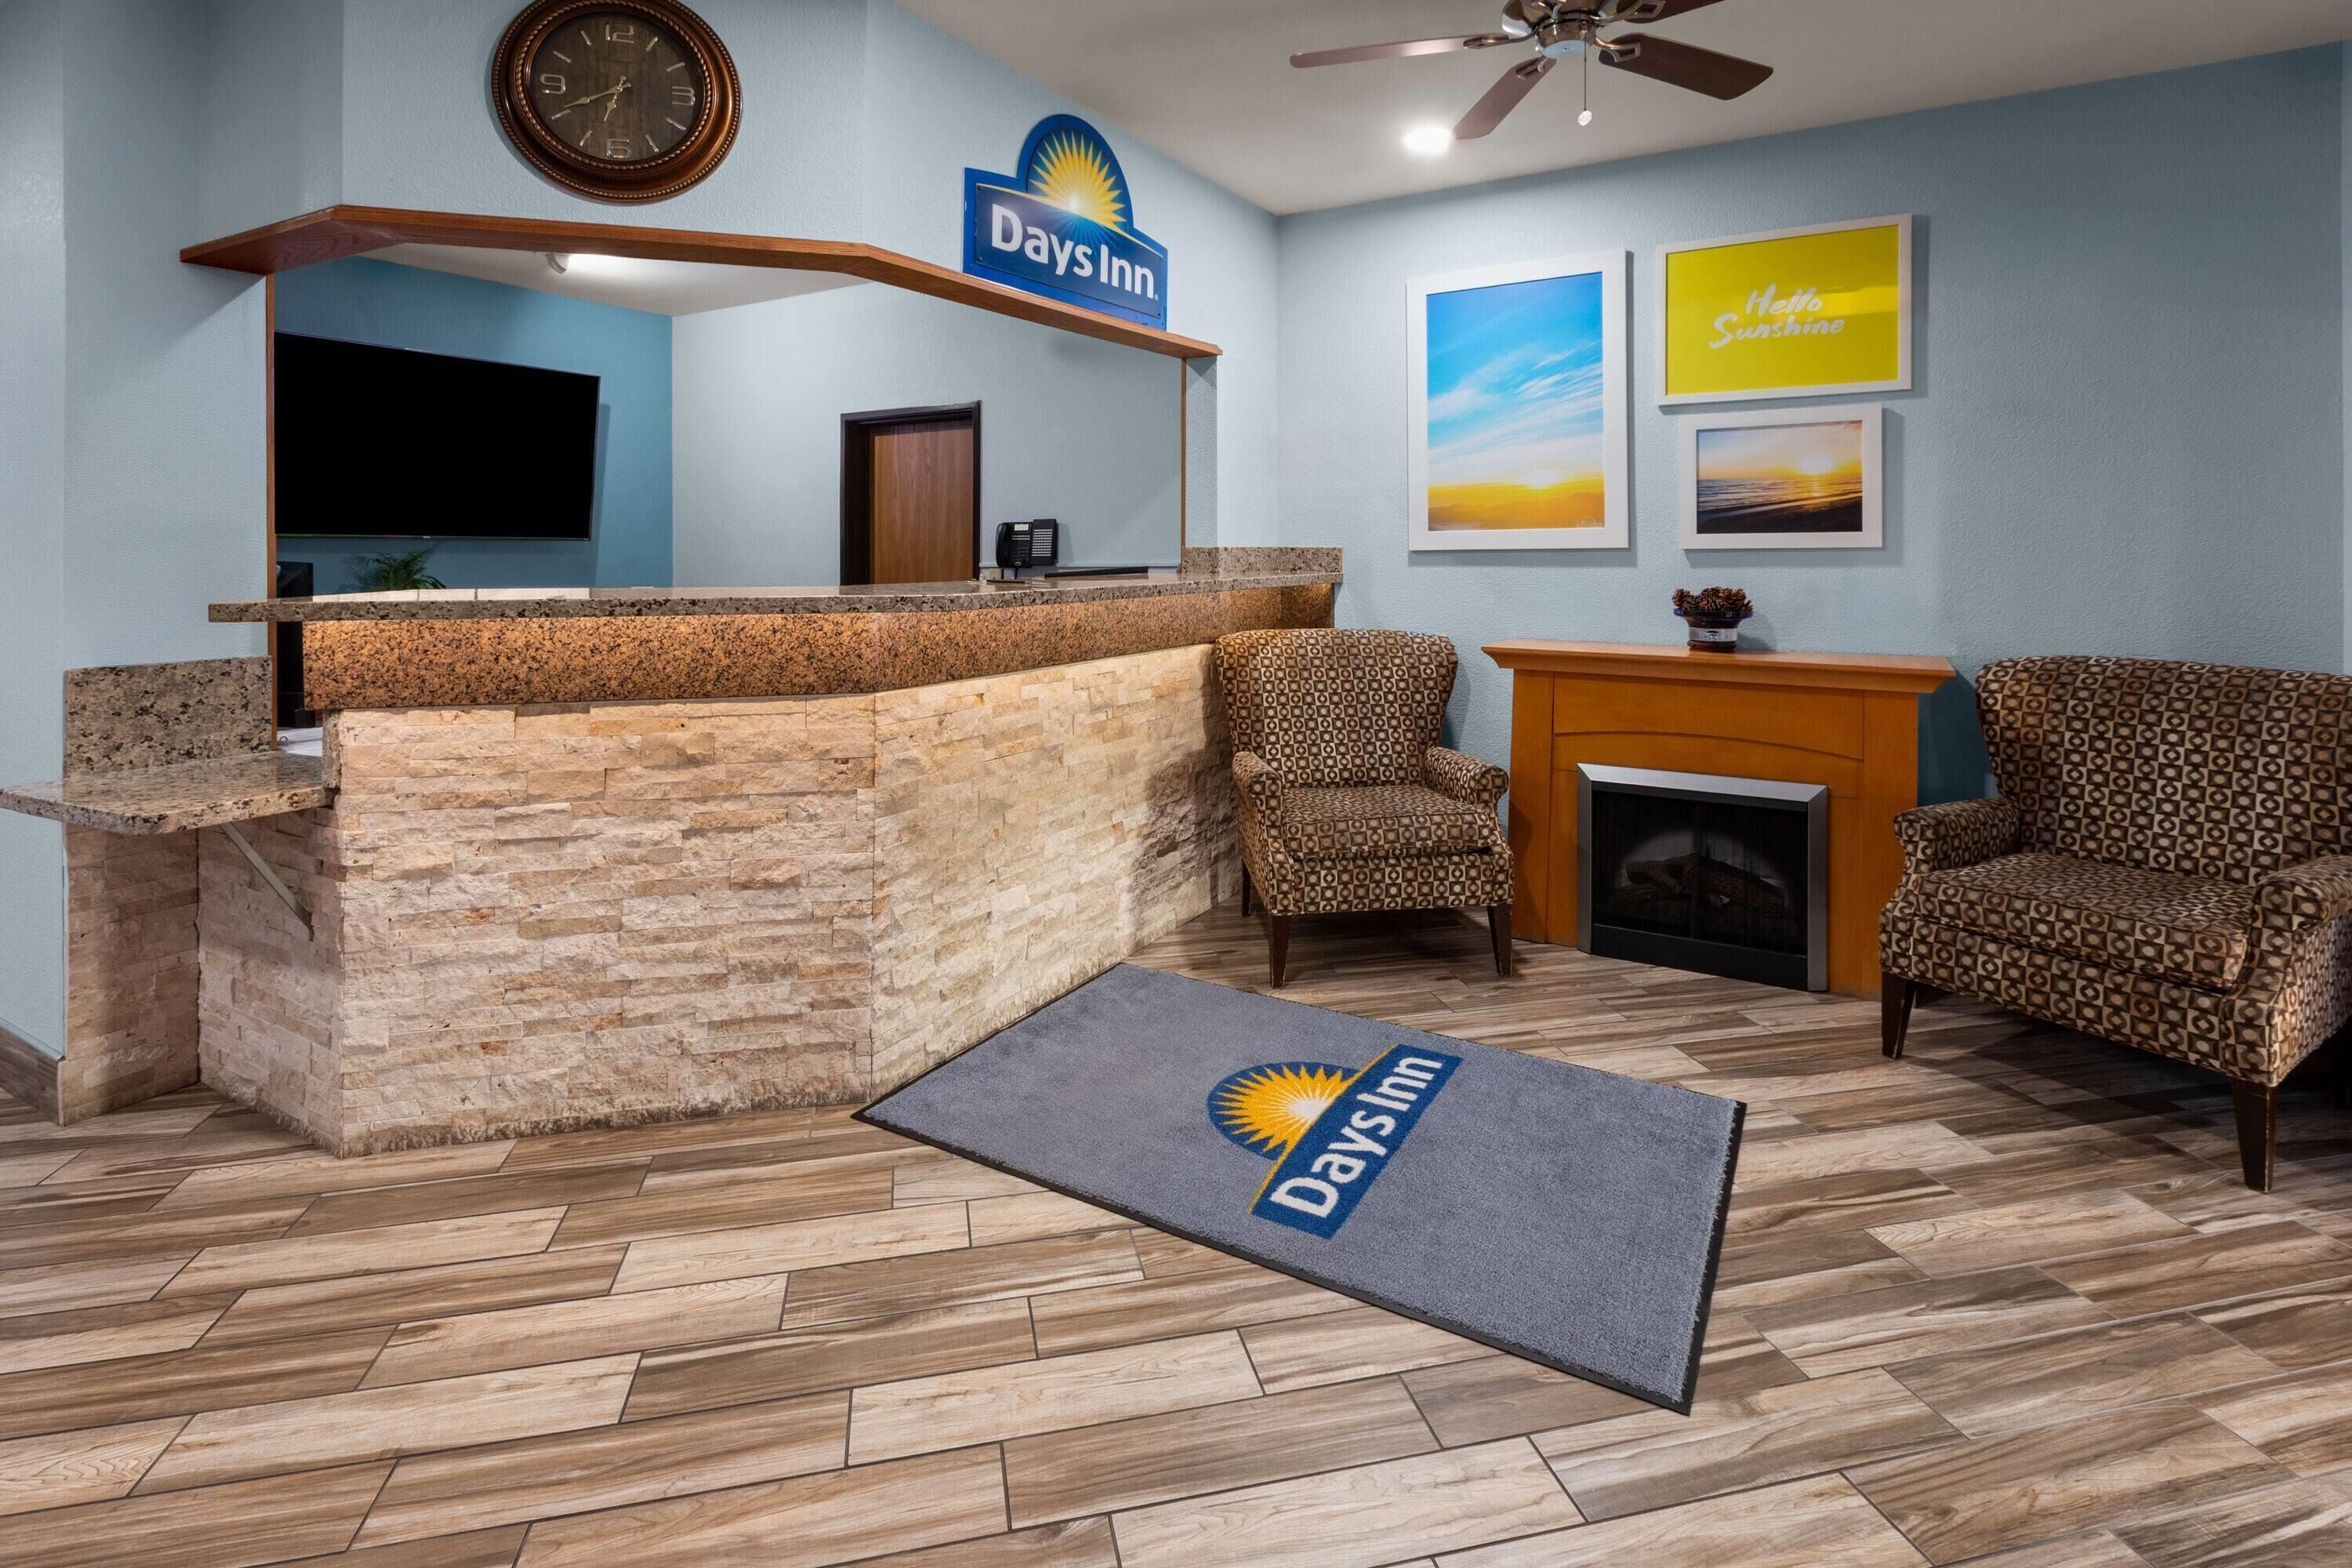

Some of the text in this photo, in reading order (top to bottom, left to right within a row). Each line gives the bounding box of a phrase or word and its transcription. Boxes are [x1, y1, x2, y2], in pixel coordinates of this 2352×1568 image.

[605, 24, 635, 44] 12
[540, 73, 566, 95] 9
[672, 86, 695, 107] 3
[991, 203, 1155, 299] Days Inn
[1745, 282, 1824, 317] Hello
[1708, 313, 1845, 349] Sunshine
[1269, 1056, 1444, 1218] Days Inn
